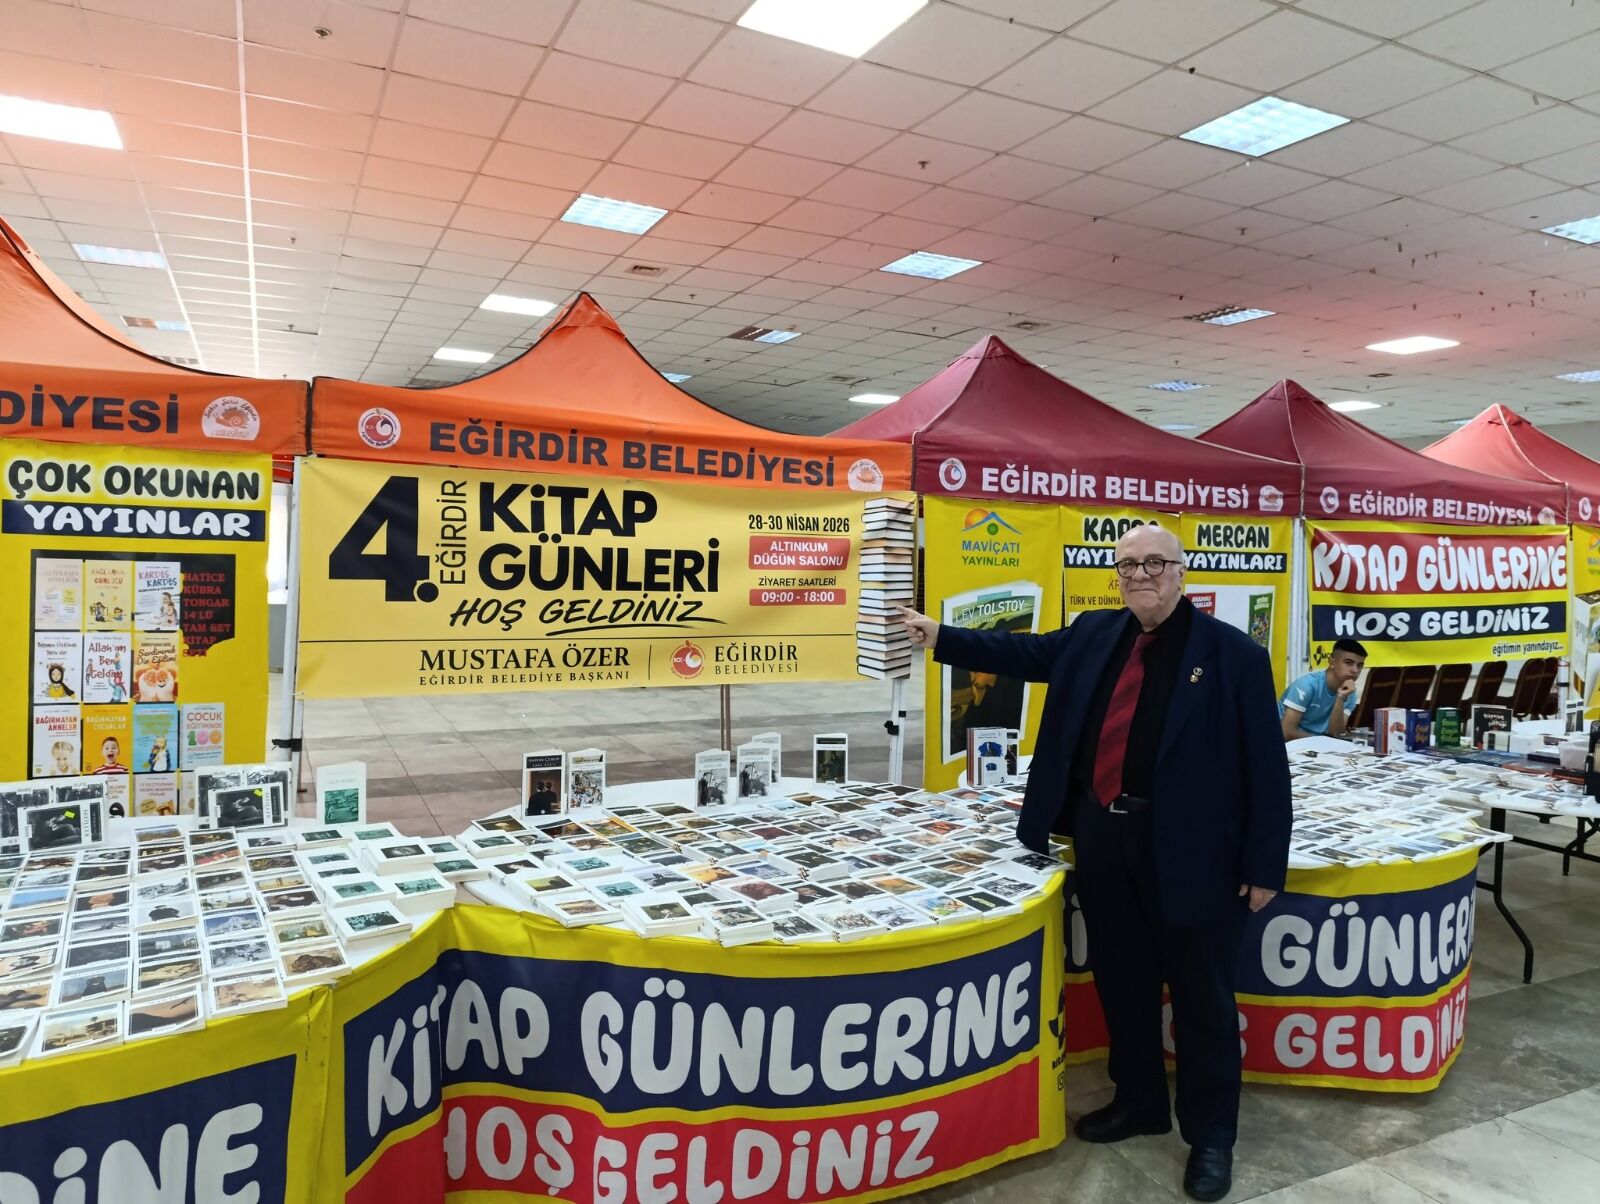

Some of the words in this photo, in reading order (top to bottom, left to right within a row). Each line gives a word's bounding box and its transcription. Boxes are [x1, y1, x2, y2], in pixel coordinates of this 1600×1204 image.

[430, 417, 609, 467] EĞİRDİR
[622, 441, 835, 487] BELEDİYESİ
[8, 460, 91, 499] ÇOK
[104, 465, 260, 500] OKUNAN
[981, 463, 1097, 499] EĞİRDİR
[1105, 477, 1250, 510] BELEDİYESİ
[1349, 489, 1428, 518] EĞİRDİR
[1432, 501, 1533, 525] BELEDİYESİ
[24, 505, 252, 538] YAYINLAR
[435, 480, 468, 585] EĞİRDİR
[748, 514, 783, 530] 28-30
[786, 513, 820, 532] NİSAN
[822, 518, 850, 532] 2026
[769, 541, 828, 553] ALTINKUM
[961, 538, 1021, 556] MAVİÇATI
[1197, 523, 1270, 549] MERCAN
[478, 532, 720, 593] GÜNLERİ
[753, 553, 796, 566] DÜĞÜN
[799, 556, 844, 567] SALONU
[961, 555, 1021, 568] YAYINLARI
[1182, 551, 1283, 571] YAYINLARI
[1416, 536, 1567, 592] GÜNLERİNE
[758, 576, 796, 587] ZİYARET
[797, 575, 837, 587] SAATLERİ
[761, 592, 794, 604] 09:00
[803, 592, 835, 603] 18:00
[1069, 594, 1086, 606] TÜRK
[1088, 596, 1097, 606] VE
[1098, 595, 1121, 606] DÜNYA
[449, 597, 526, 632] HOŞ
[955, 607, 975, 623] LEV
[976, 599, 1026, 617] TOLSTOY
[1334, 609, 1411, 640] HOŞ
[1419, 606, 1550, 637] GELDİNİZ
[419, 647, 556, 671] MUSTAFA
[561, 643, 630, 668] ÖZER
[714, 642, 798, 661] EĞİRDİR
[1492, 640, 1521, 656] eğitimin
[419, 672, 484, 686] EĞİRDİR
[491, 671, 563, 684] BELEDİYE
[569, 671, 629, 683] BAŞKANI
[714, 663, 799, 675] BELEDİYESİ
[580, 960, 1033, 1097] GÜNLERİNE
[443, 1105, 575, 1196] HOŞ
